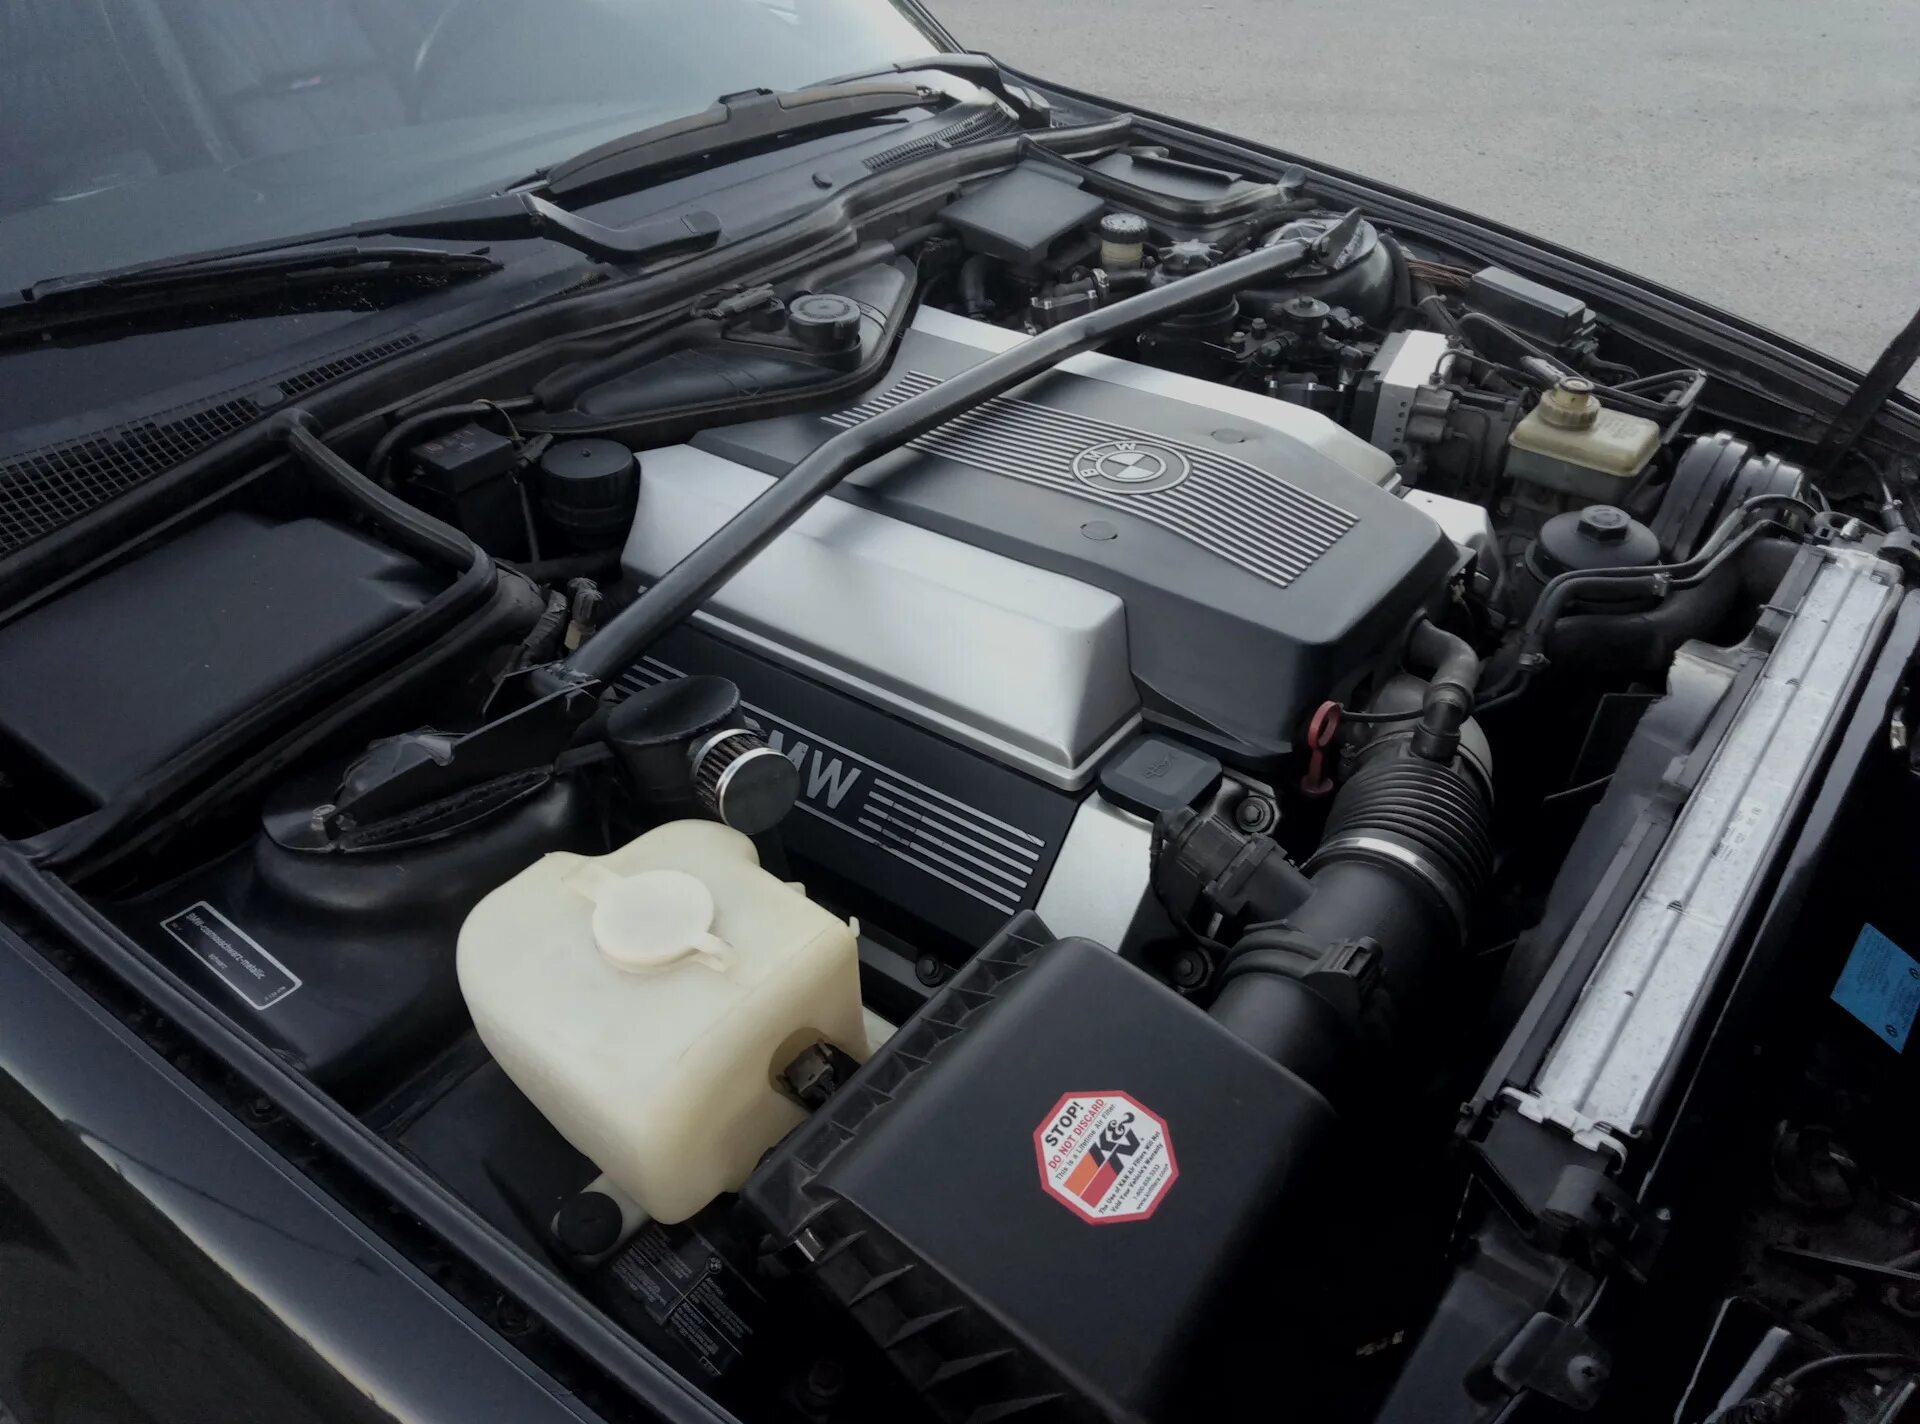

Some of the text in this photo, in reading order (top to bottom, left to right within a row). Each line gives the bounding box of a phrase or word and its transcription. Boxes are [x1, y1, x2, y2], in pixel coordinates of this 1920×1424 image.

[1080, 443, 1136, 478] BMW
[1044, 1100, 1085, 1148] STOP!
[1048, 1097, 1106, 1169] DO NOT DISCARD
[1056, 1165, 1069, 1180] This
[1066, 1158, 1074, 1166] is
[1076, 1128, 1097, 1153] Lifetime
[1094, 1118, 1104, 1129] Air
[1088, 1112, 1141, 1175] K&N
